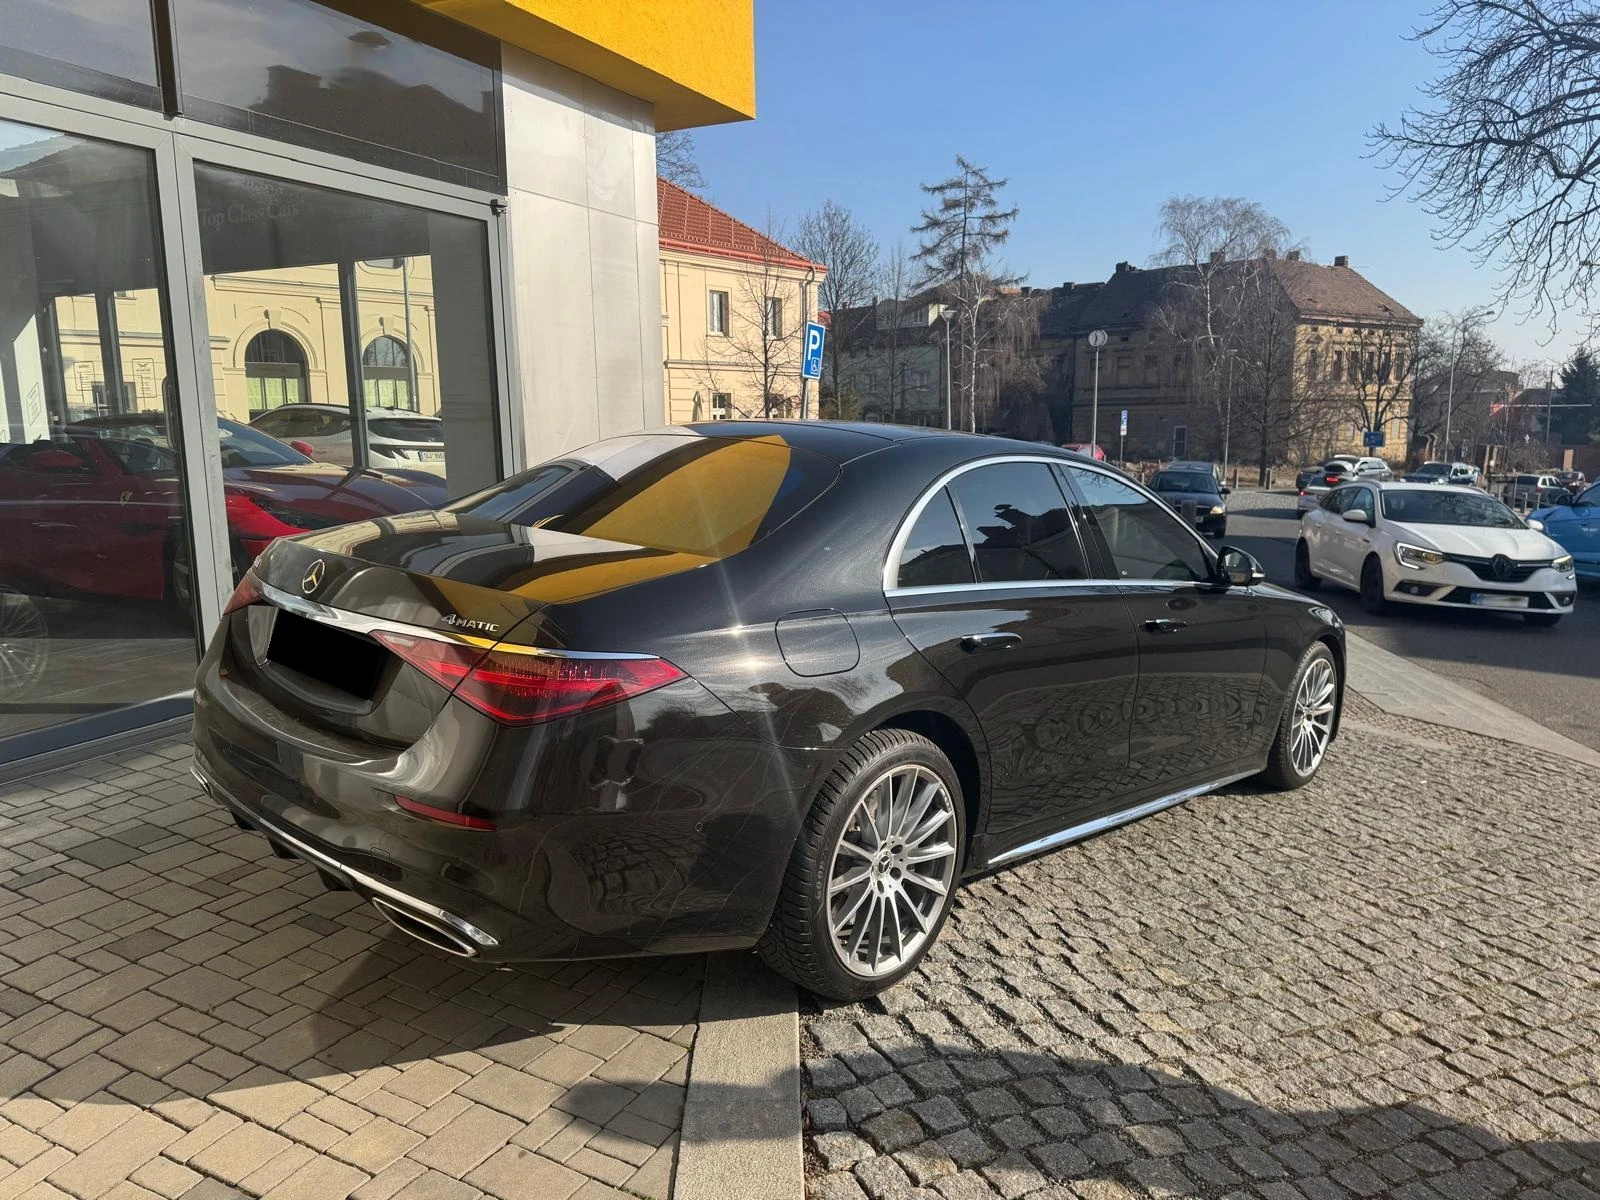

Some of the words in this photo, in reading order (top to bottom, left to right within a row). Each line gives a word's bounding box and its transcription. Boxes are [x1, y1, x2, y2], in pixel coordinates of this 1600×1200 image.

[199, 207, 225, 231] Top
[228, 203, 264, 222] Class
[808, 329, 821, 360] P
[441, 613, 500, 632] 4MATIC
